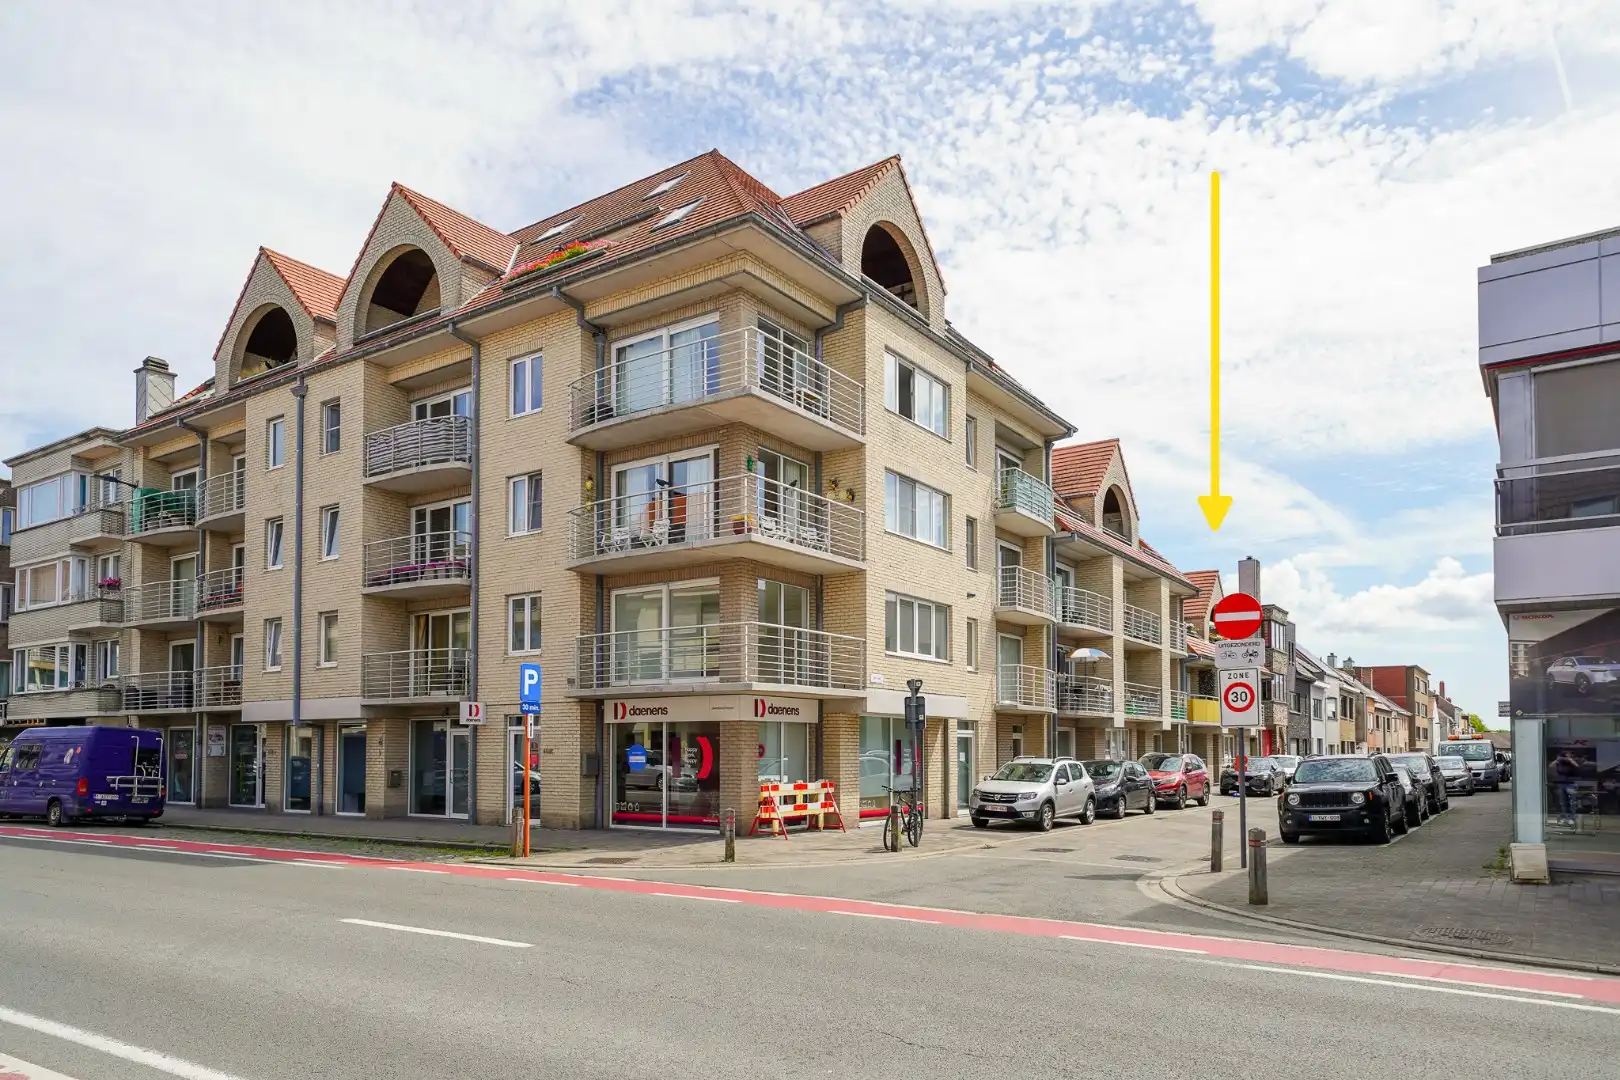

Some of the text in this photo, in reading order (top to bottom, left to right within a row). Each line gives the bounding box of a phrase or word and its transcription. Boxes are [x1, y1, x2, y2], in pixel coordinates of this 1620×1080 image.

[1227, 672, 1250, 680] ZONE
[524, 669, 539, 695] P
[1231, 691, 1248, 703] 30
[522, 703, 529, 711] 30
[628, 705, 669, 716] daenens
[768, 703, 800, 716] daenens
